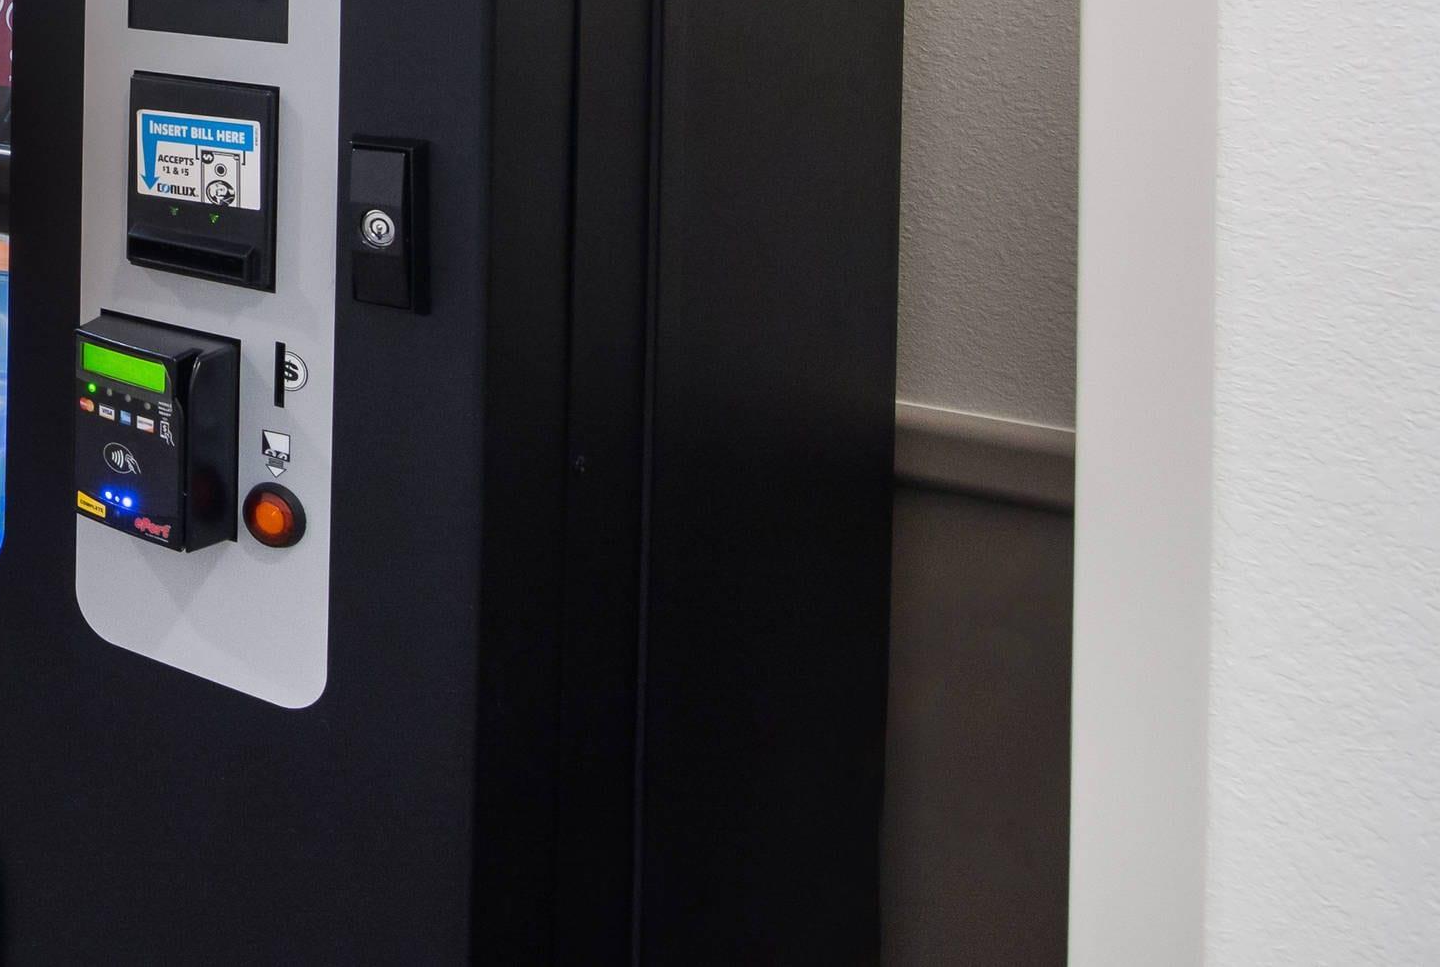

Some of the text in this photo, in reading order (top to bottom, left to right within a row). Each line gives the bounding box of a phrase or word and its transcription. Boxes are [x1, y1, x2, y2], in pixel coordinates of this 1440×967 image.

[150, 120, 189, 139] INSERT
[191, 126, 214, 142] BILL
[216, 130, 246, 145] HERE
[157, 154, 195, 167] ACCEPTS
[173, 166, 179, 175] &
